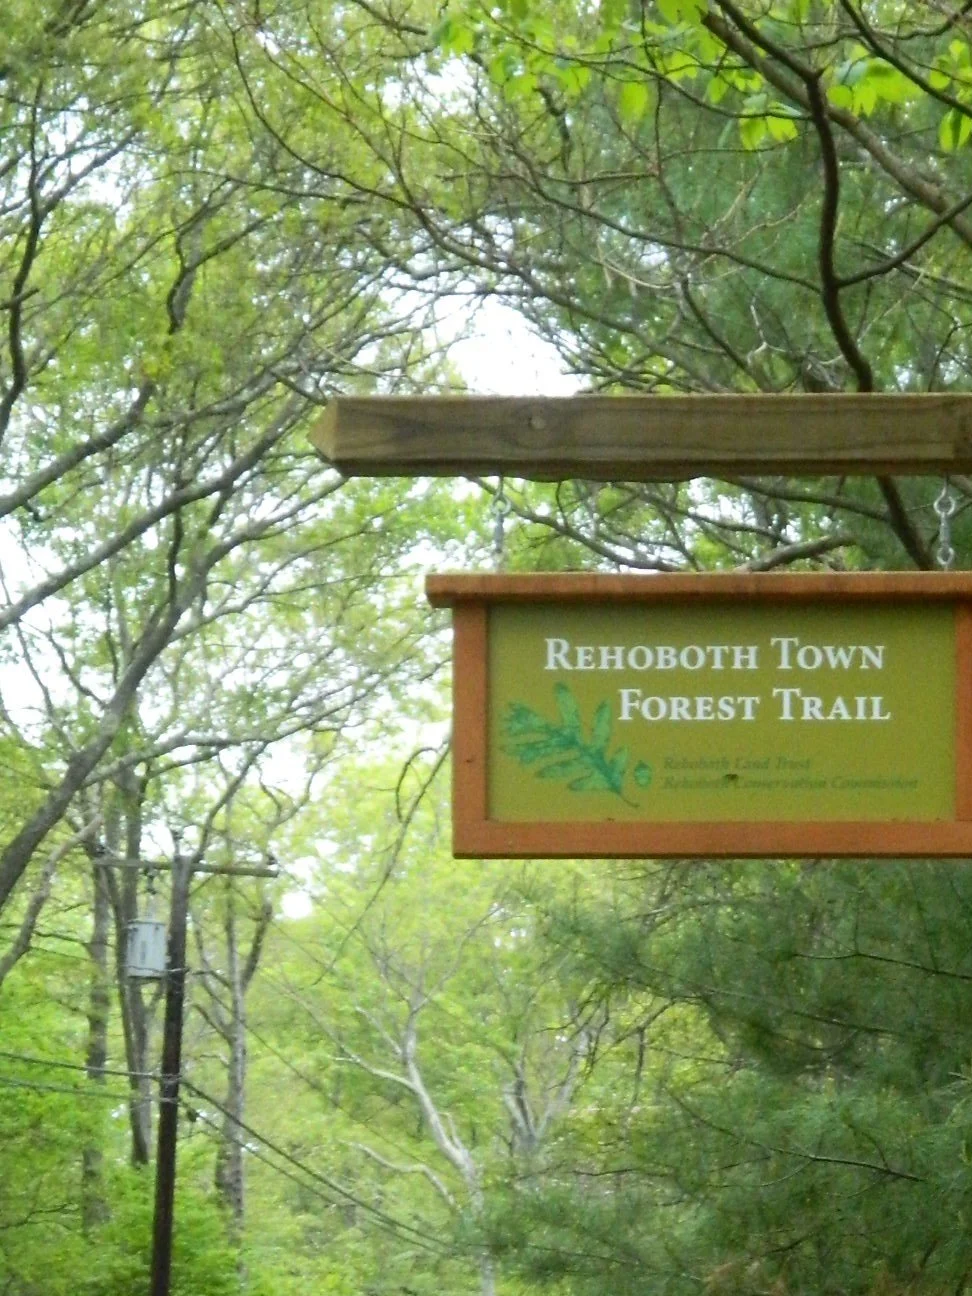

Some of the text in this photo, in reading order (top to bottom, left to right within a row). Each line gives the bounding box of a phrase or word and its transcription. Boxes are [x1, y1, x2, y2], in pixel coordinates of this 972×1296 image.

[544, 636, 886, 670] REHOBOTH TOWN
[617, 687, 892, 721] FOREST TRAIL
